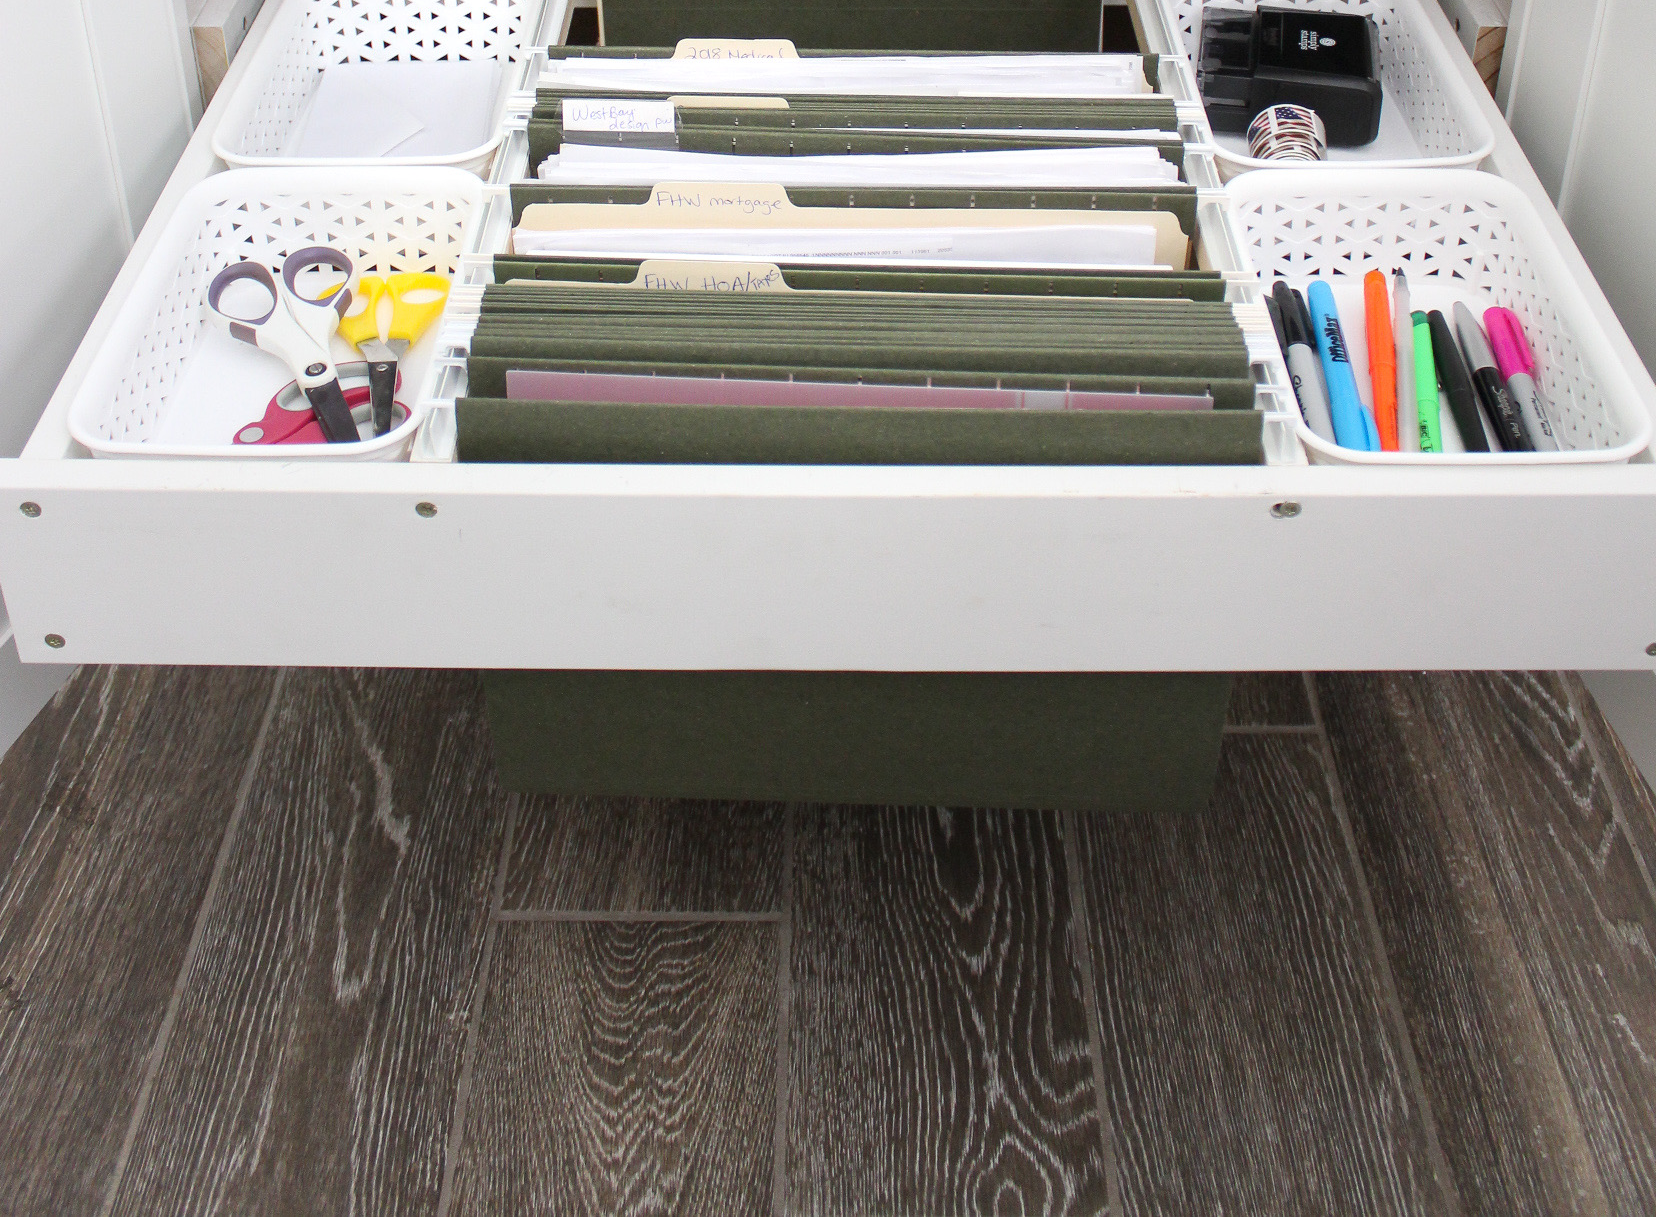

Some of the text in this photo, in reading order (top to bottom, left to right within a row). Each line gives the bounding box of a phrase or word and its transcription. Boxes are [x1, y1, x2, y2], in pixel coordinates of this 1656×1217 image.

[1298, 30, 1309, 51] stamps
[1308, 31, 1320, 51] simply
[609, 118, 650, 132] design
[656, 191, 782, 215] FHW mortgage
